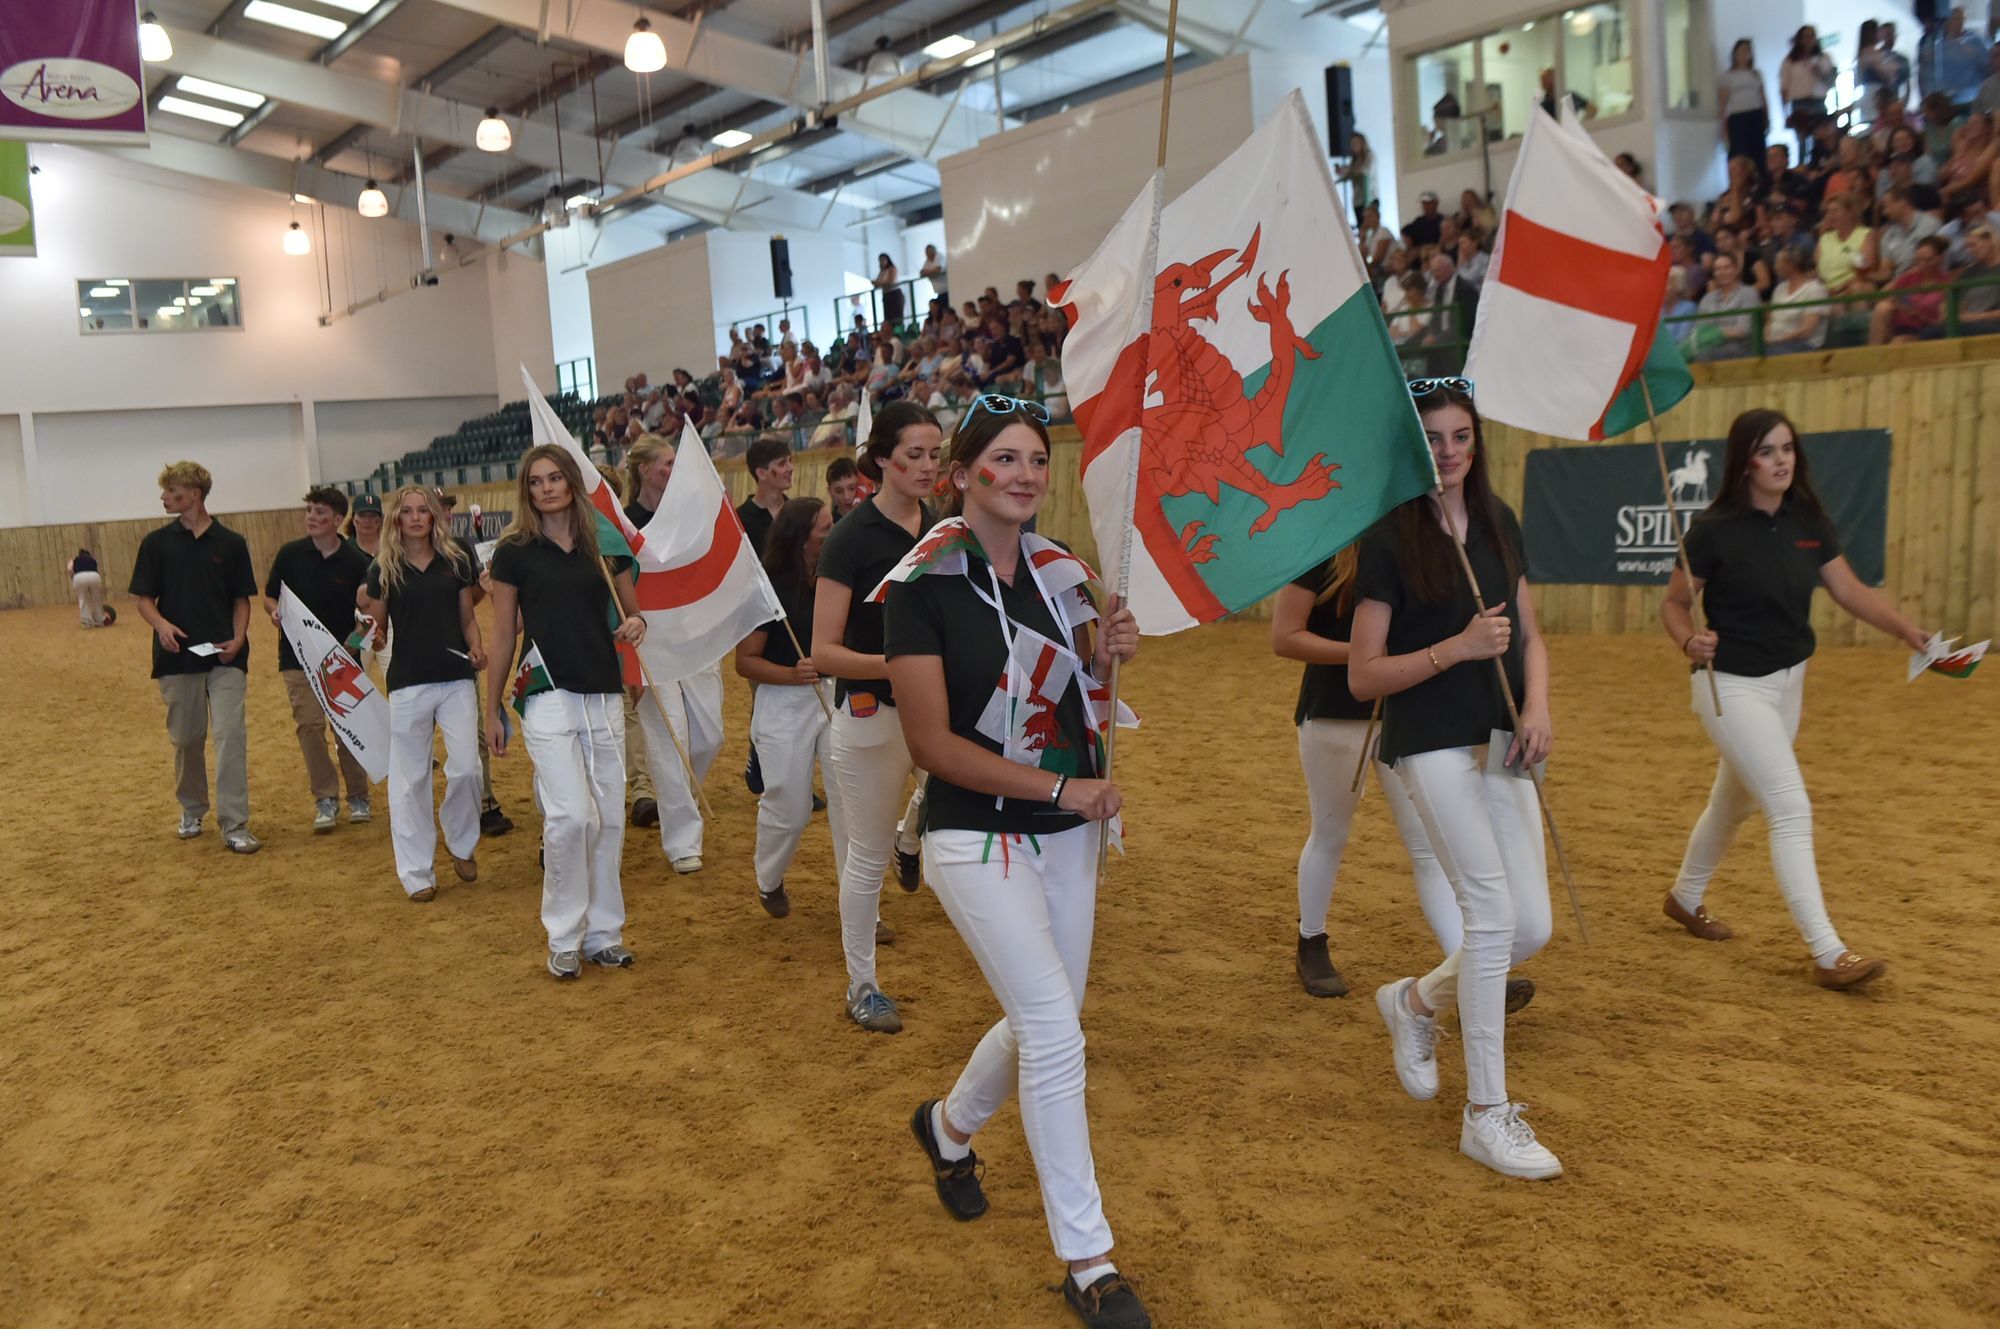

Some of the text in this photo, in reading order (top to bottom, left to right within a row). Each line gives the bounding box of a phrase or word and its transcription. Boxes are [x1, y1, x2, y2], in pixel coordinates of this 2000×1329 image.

[21, 63, 101, 104] Arena
[451, 515, 468, 538] HOP
[1615, 505, 1694, 547] SPILL
